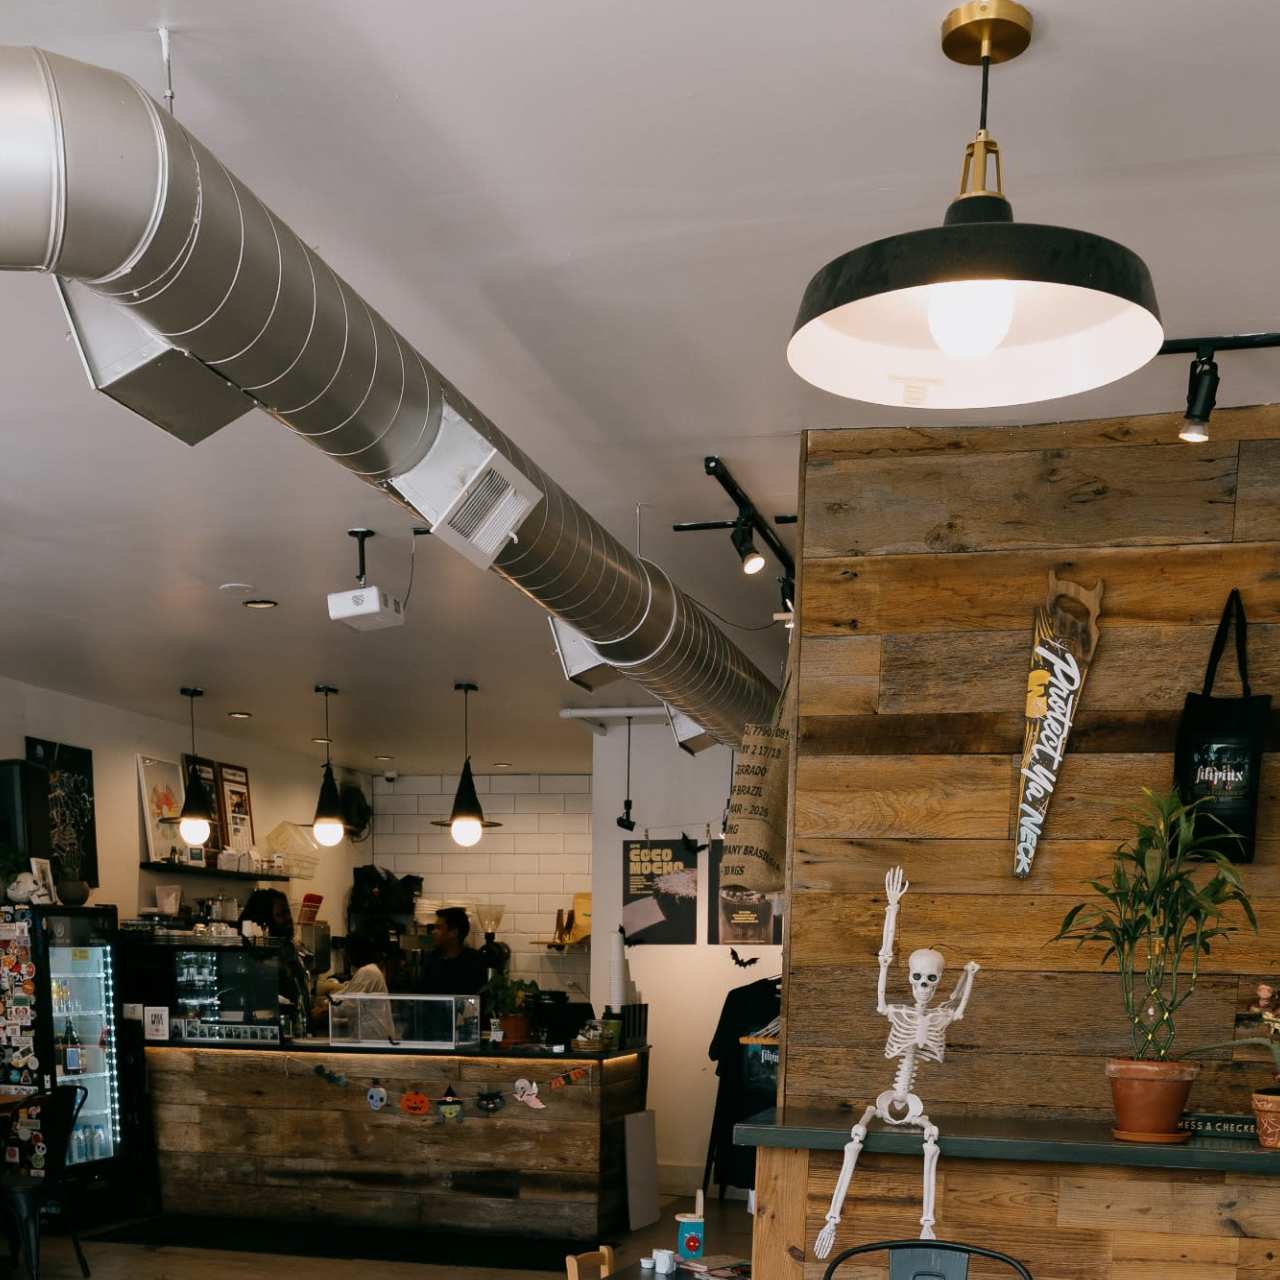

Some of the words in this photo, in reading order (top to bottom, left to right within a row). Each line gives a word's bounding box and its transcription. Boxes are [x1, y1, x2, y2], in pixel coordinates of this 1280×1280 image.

[1032, 645, 1081, 770] Protect
[1021, 762, 1057, 802] Ya
[629, 848, 673, 862] COCO
[1015, 802, 1043, 875] NECK
